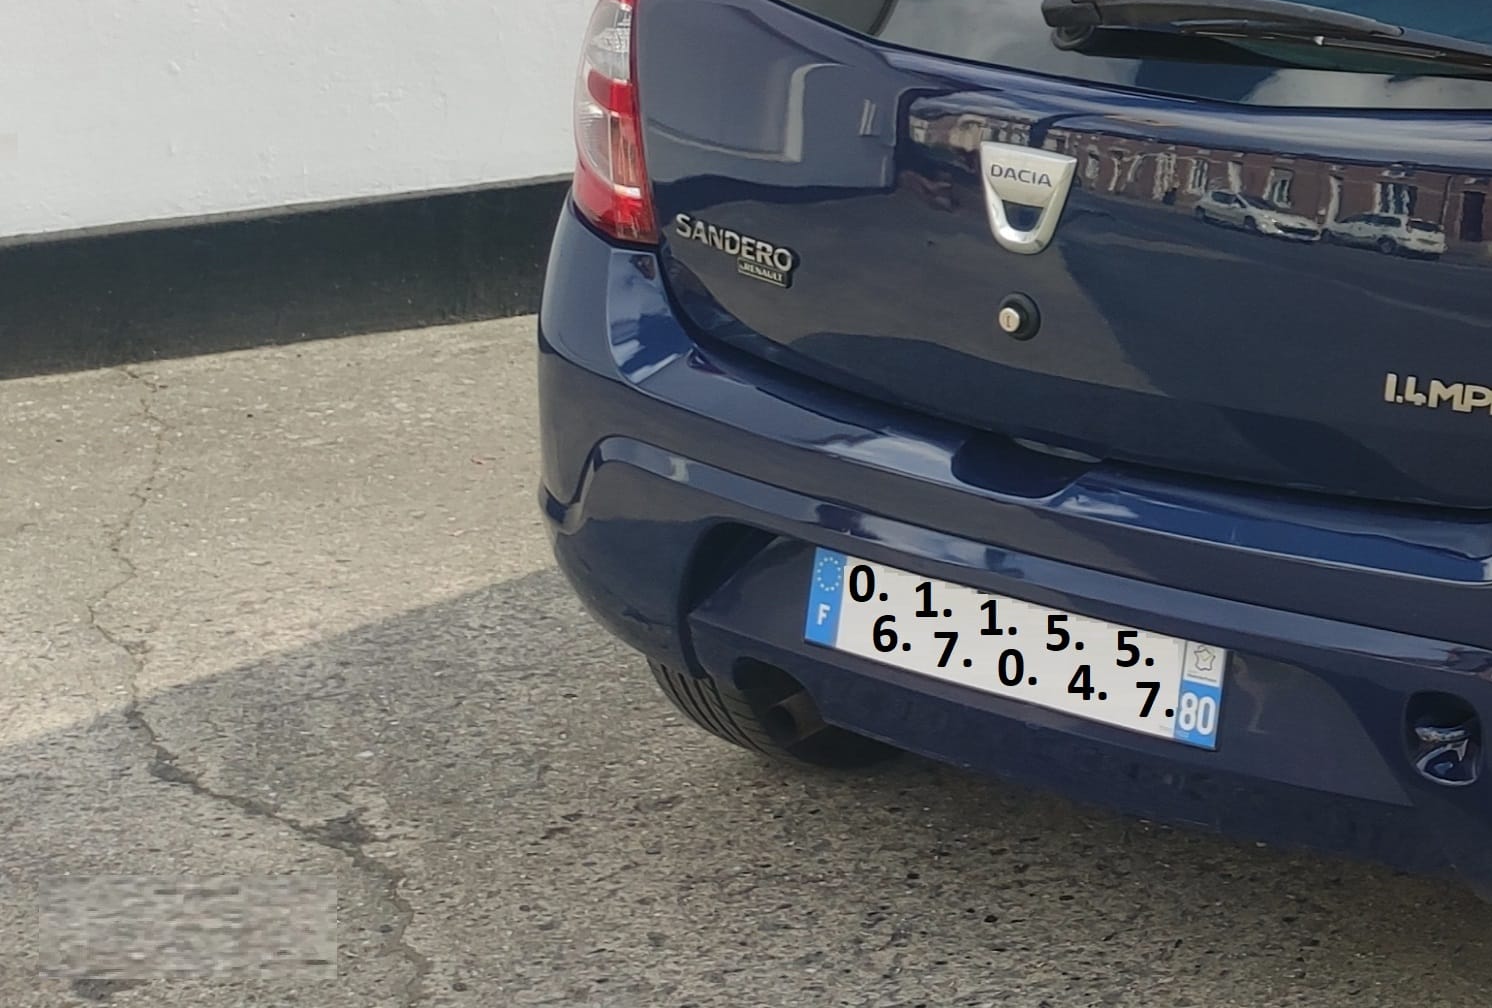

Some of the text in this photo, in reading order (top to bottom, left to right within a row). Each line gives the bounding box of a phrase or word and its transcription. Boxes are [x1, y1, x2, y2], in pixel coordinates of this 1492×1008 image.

[989, 163, 1053, 189] DACIA
[676, 212, 793, 272] SANDERO
[816, 604, 831, 625] F
[1179, 691, 1216, 735] 80
